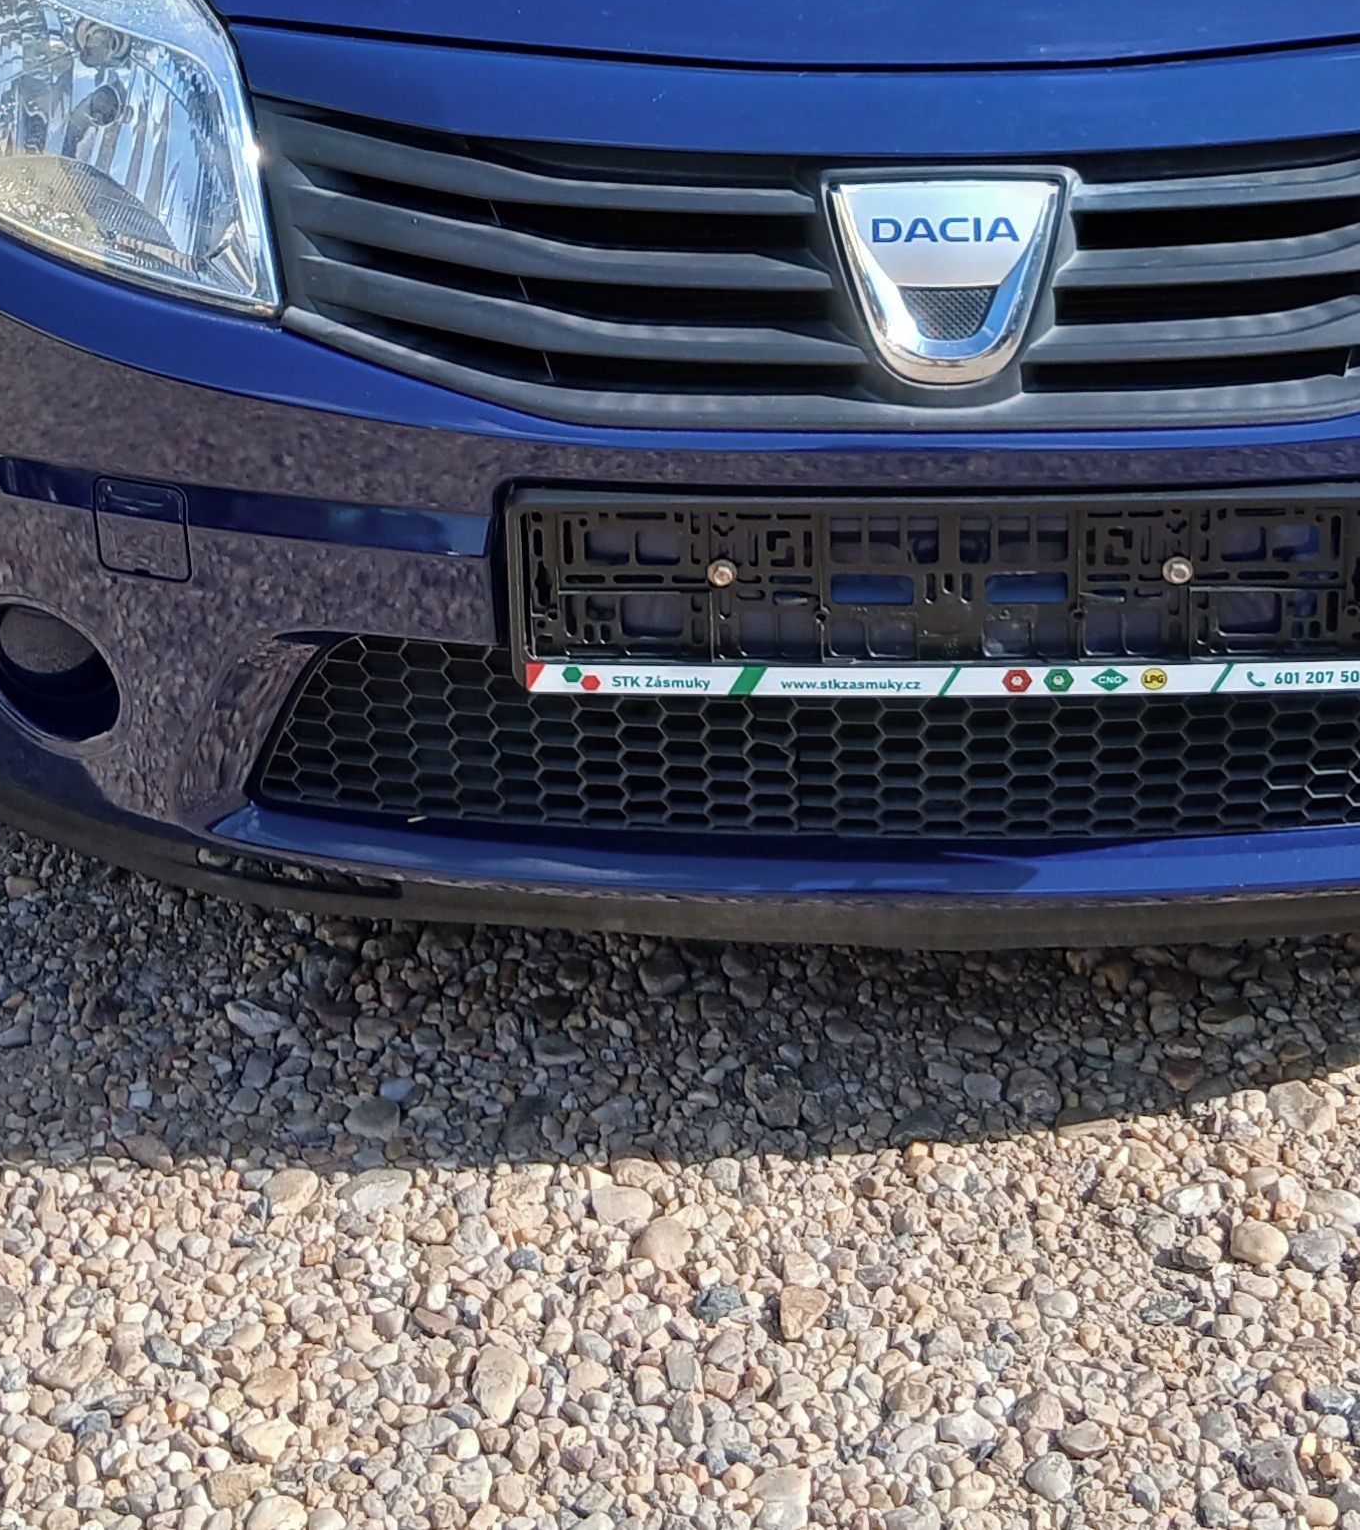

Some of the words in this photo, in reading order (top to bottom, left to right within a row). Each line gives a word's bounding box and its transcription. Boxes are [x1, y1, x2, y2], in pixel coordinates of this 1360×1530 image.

[871, 217, 1020, 243] DACIA
[612, 675, 640, 688] STK
[645, 675, 710, 691] Zásmuky
[1097, 675, 1123, 684] CNG
[1144, 674, 1164, 684] LPG
[1274, 671, 1300, 684] 601
[1305, 671, 1334, 684] 207
[780, 678, 921, 692] www.stkzasmuky.cz
